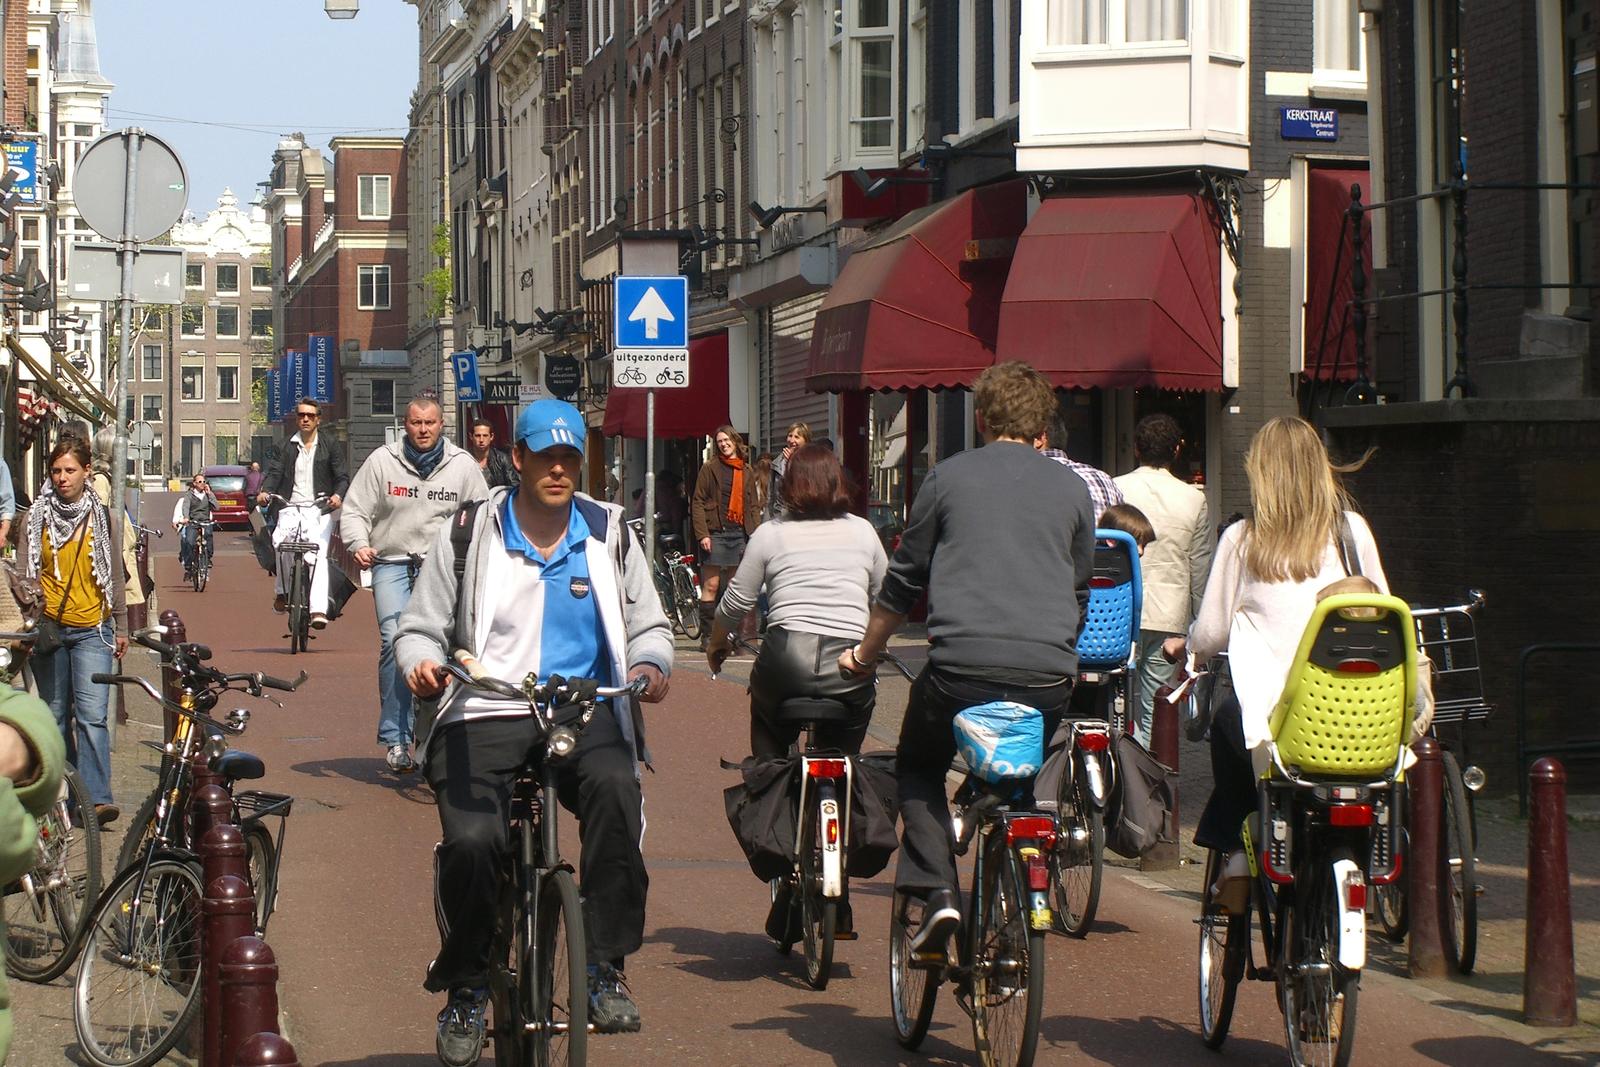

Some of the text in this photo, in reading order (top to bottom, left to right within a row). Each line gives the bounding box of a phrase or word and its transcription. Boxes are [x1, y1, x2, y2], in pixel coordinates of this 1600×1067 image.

[1286, 109, 1335, 122] KERKSTRAAT
[317, 337, 326, 395] SPIEGELHOF
[457, 357, 470, 381] P
[616, 353, 686, 364] uitgezonderd
[273, 370, 281, 415] SPIEGELHOF
